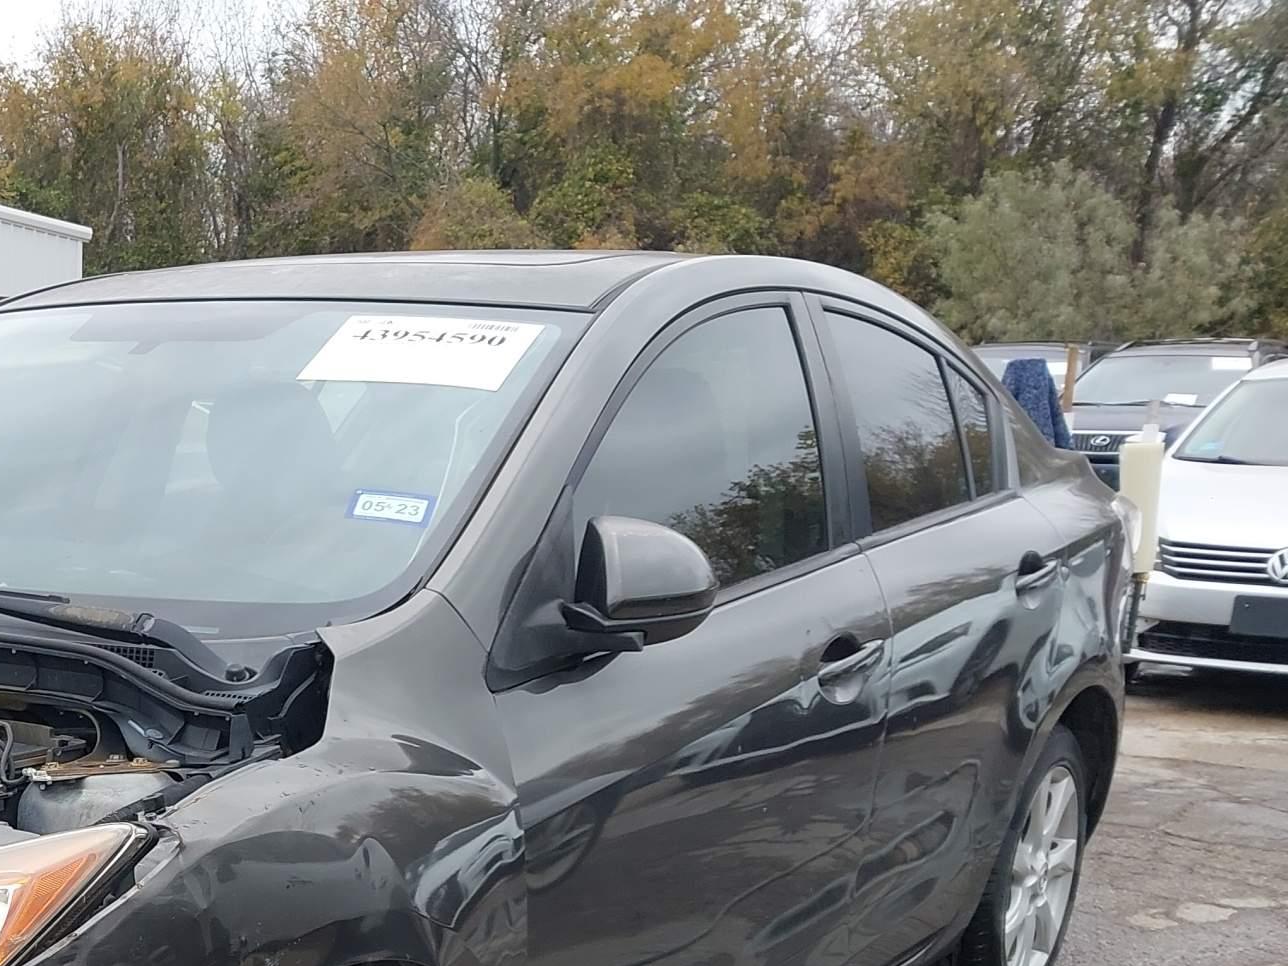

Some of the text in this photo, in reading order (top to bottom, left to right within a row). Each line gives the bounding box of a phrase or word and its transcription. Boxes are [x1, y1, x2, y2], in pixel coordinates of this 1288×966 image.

[352, 328, 507, 347] 43954590
[361, 500, 421, 517] 05 23
